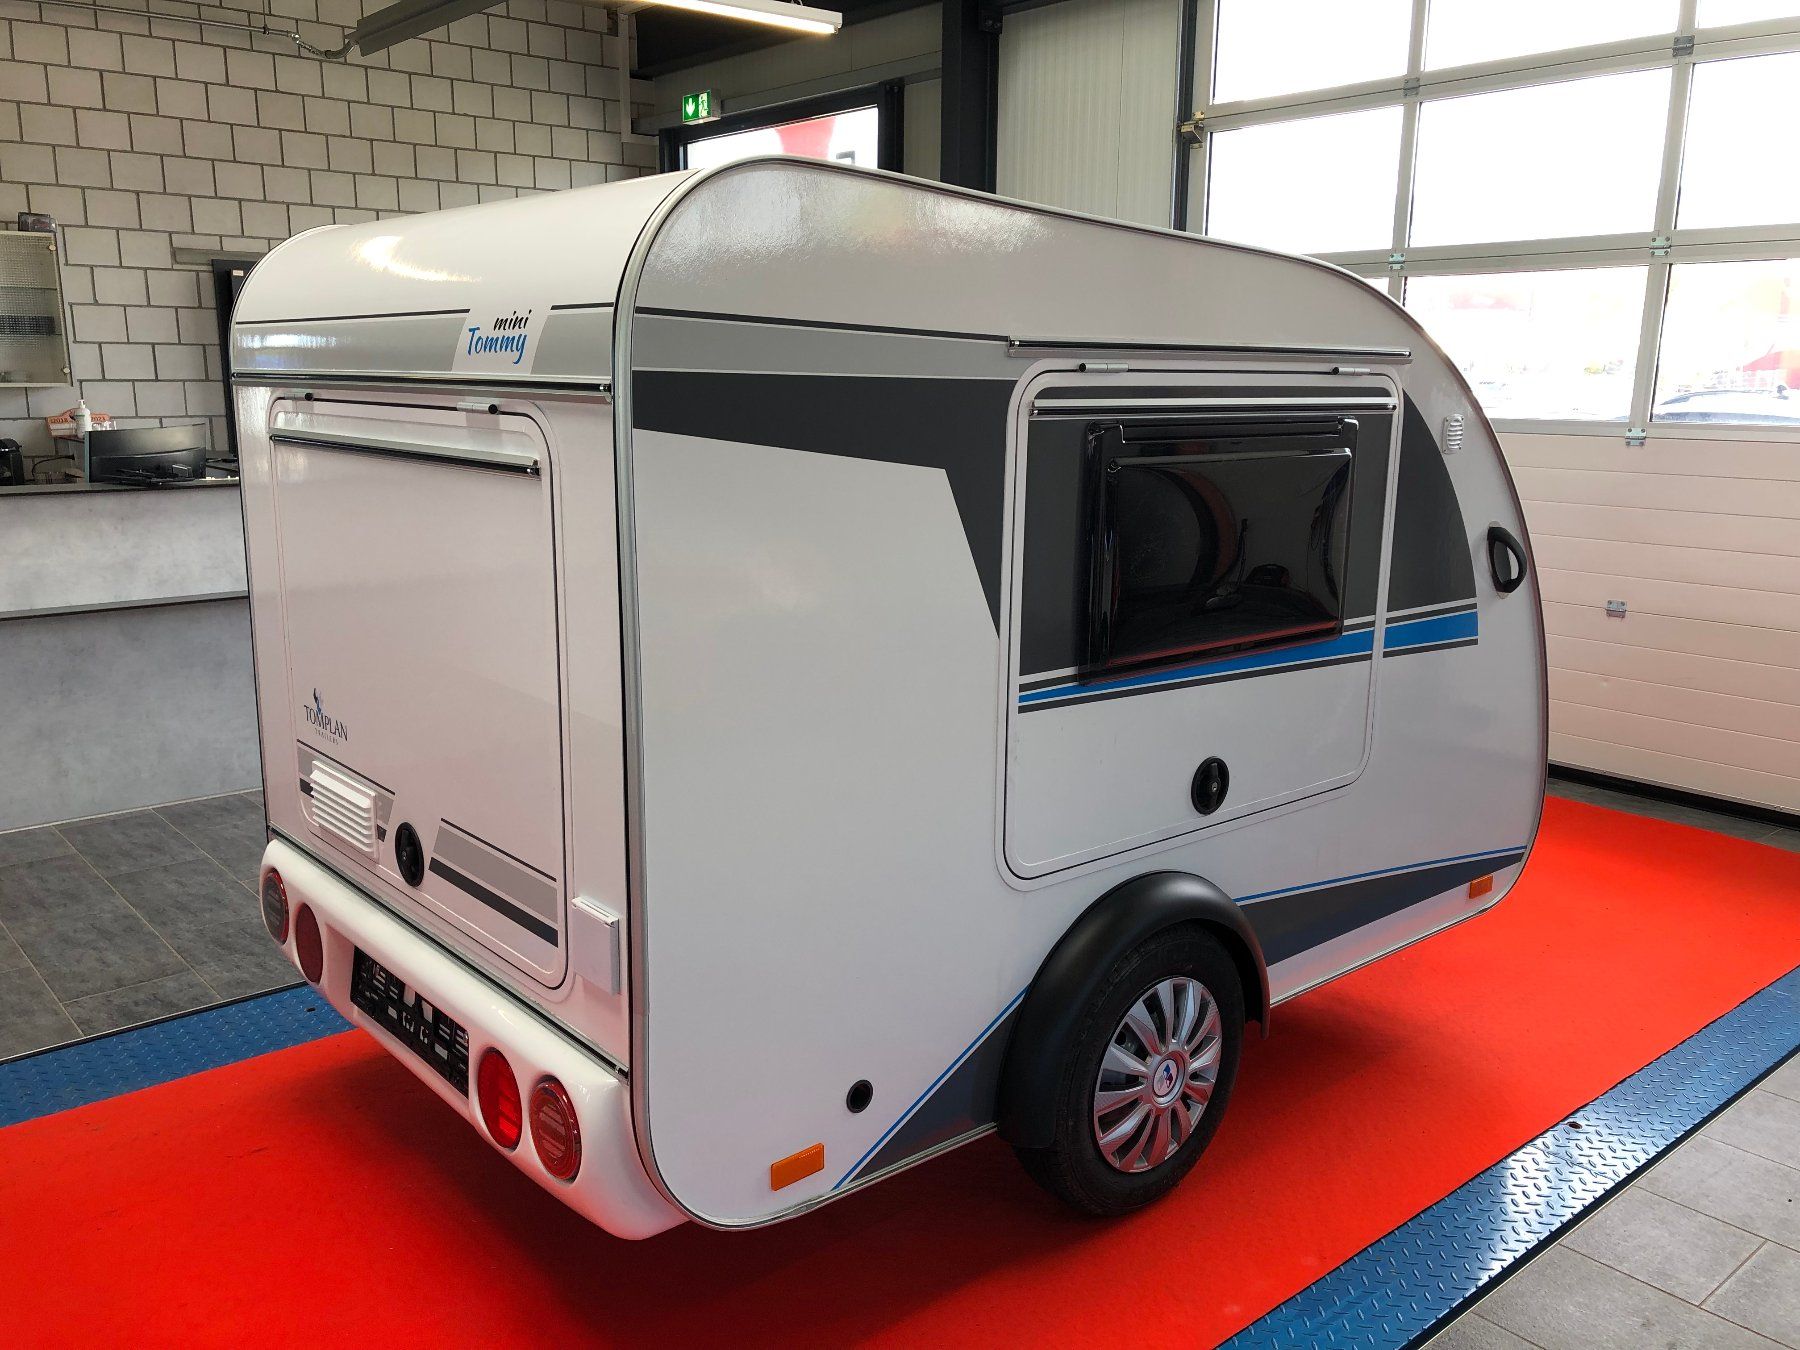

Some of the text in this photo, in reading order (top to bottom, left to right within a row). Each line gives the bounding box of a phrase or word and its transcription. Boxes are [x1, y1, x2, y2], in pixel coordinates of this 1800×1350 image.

[493, 308, 532, 331] mini
[467, 326, 527, 365] Tommy
[303, 704, 348, 742] TOMPLAN
